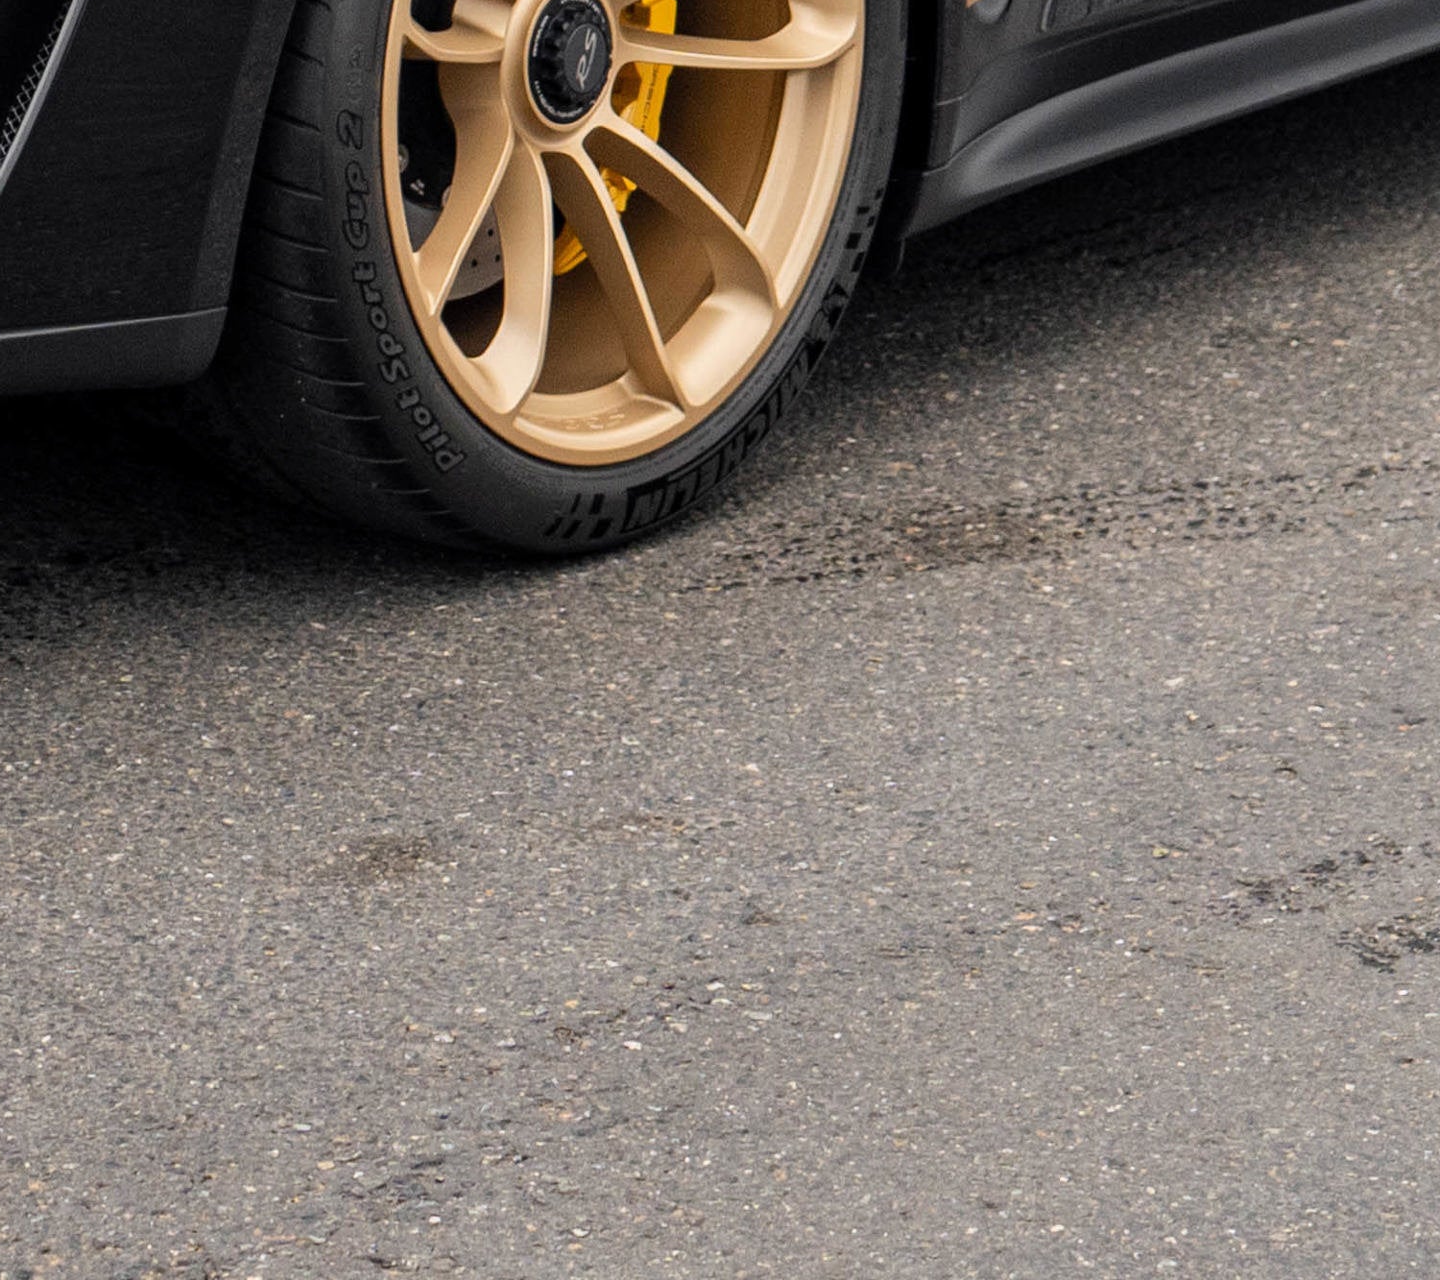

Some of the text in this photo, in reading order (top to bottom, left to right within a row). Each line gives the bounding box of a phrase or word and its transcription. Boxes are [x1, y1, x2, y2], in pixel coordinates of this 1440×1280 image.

[336, 109, 364, 151] 2
[342, 160, 370, 250] Cup
[351, 261, 409, 384] Sport
[397, 390, 465, 473] Pilot
